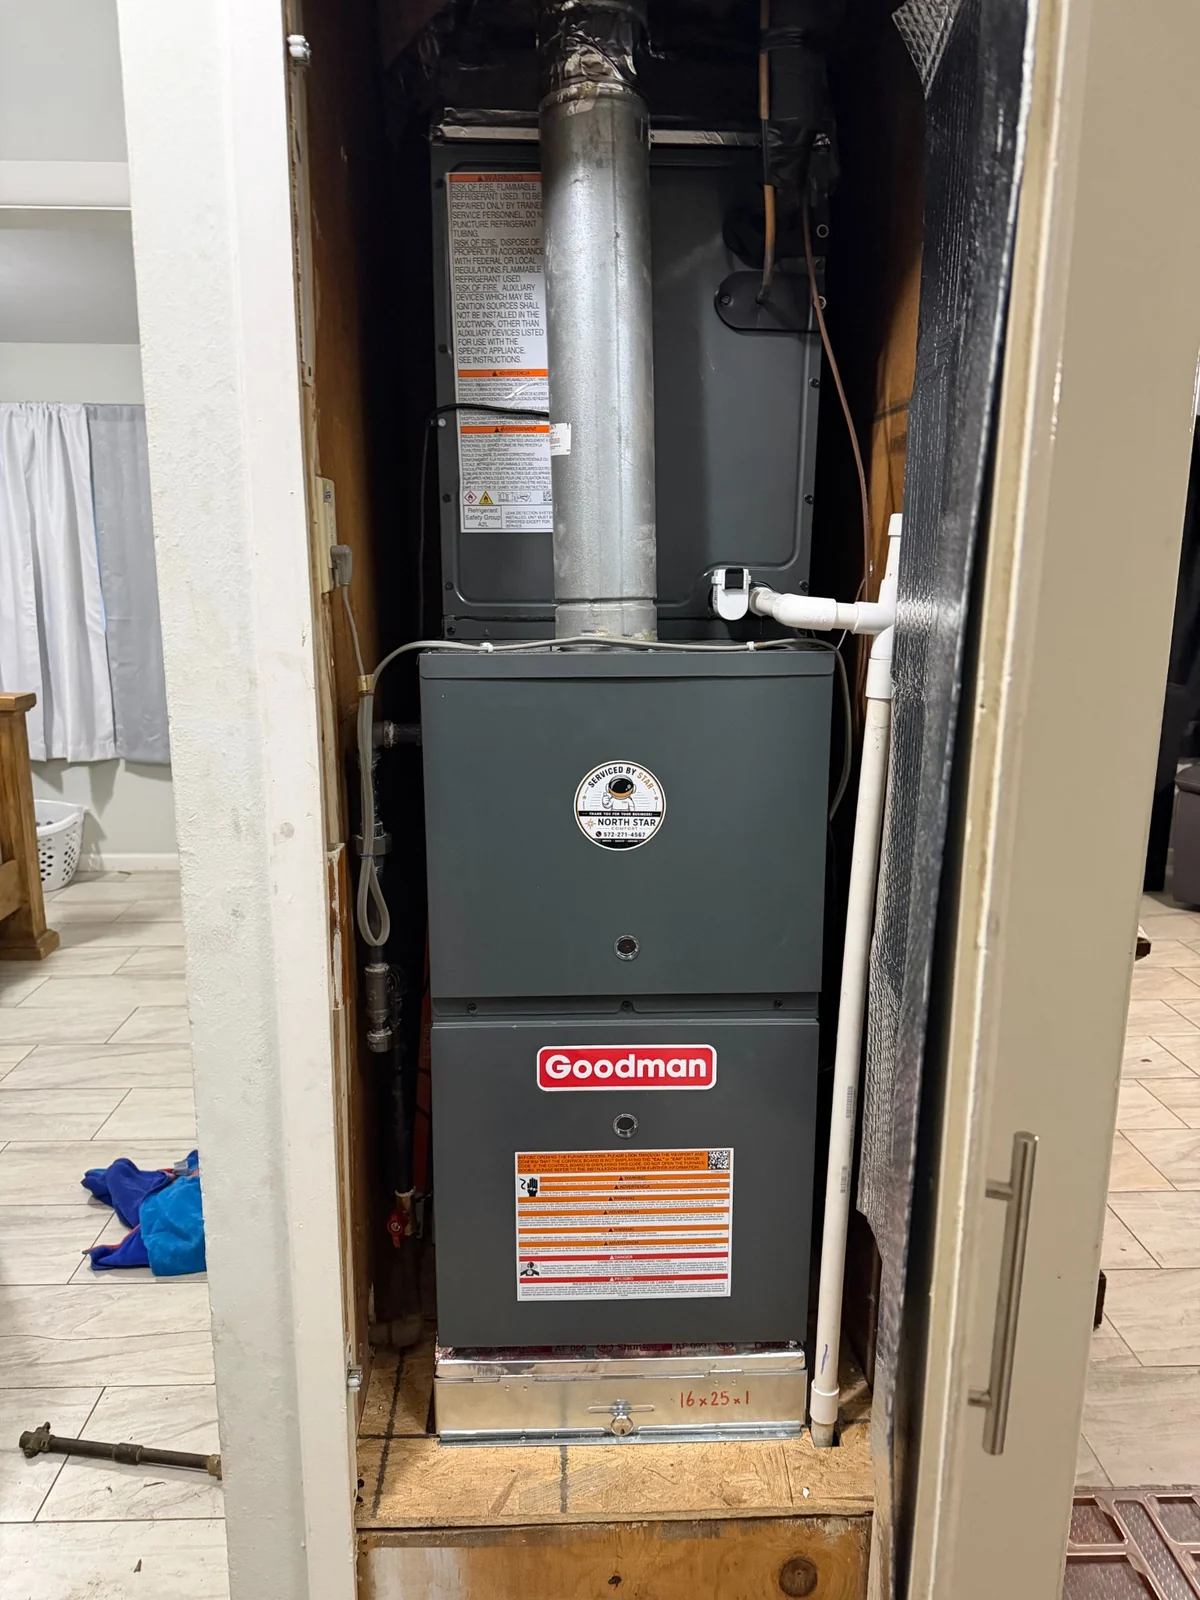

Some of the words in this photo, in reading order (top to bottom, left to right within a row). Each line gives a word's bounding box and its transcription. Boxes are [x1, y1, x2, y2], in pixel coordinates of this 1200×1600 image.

[451, 183, 466, 191] RISK
[468, 183, 477, 191] OF
[497, 183, 536, 191] FLAMMABLE
[452, 202, 485, 210] REPAIRED
[487, 202, 504, 210] ONLY
[506, 202, 515, 210] BY
[518, 202, 542, 210] TRAINE
[452, 211, 481, 219] SERVICE
[454, 239, 468, 247] RISK
[455, 248, 489, 256] PROPERLY
[473, 257, 502, 265] FEDERAL
[456, 275, 500, 283] REFRIGERANT
[456, 284, 470, 292] RISK
[472, 284, 481, 292] OF
[456, 293, 484, 301] DEVICES
[486, 293, 507, 301] WHICH
[457, 302, 485, 310] IGNITION
[486, 302, 518, 310] SOURCES
[520, 302, 540, 310] SHALL
[482, 311, 517, 319] INSTALLED
[498, 320, 520, 328] OTHER
[522, 320, 539, 328] THAN
[492, 329, 520, 337] DEVICES
[473, 338, 486, 346] USE
[488, 338, 504, 346] WITH
[458, 347, 488, 355] SPECIFIC
[459, 356, 472, 364] SEE
[588, 766, 623, 788] SERVICED
[626, 767, 637, 776] BY
[637, 772, 654, 790] STAR
[598, 818, 630, 826] NORTH
[633, 819, 656, 827] STAR
[545, 1054, 707, 1079] Goodman
